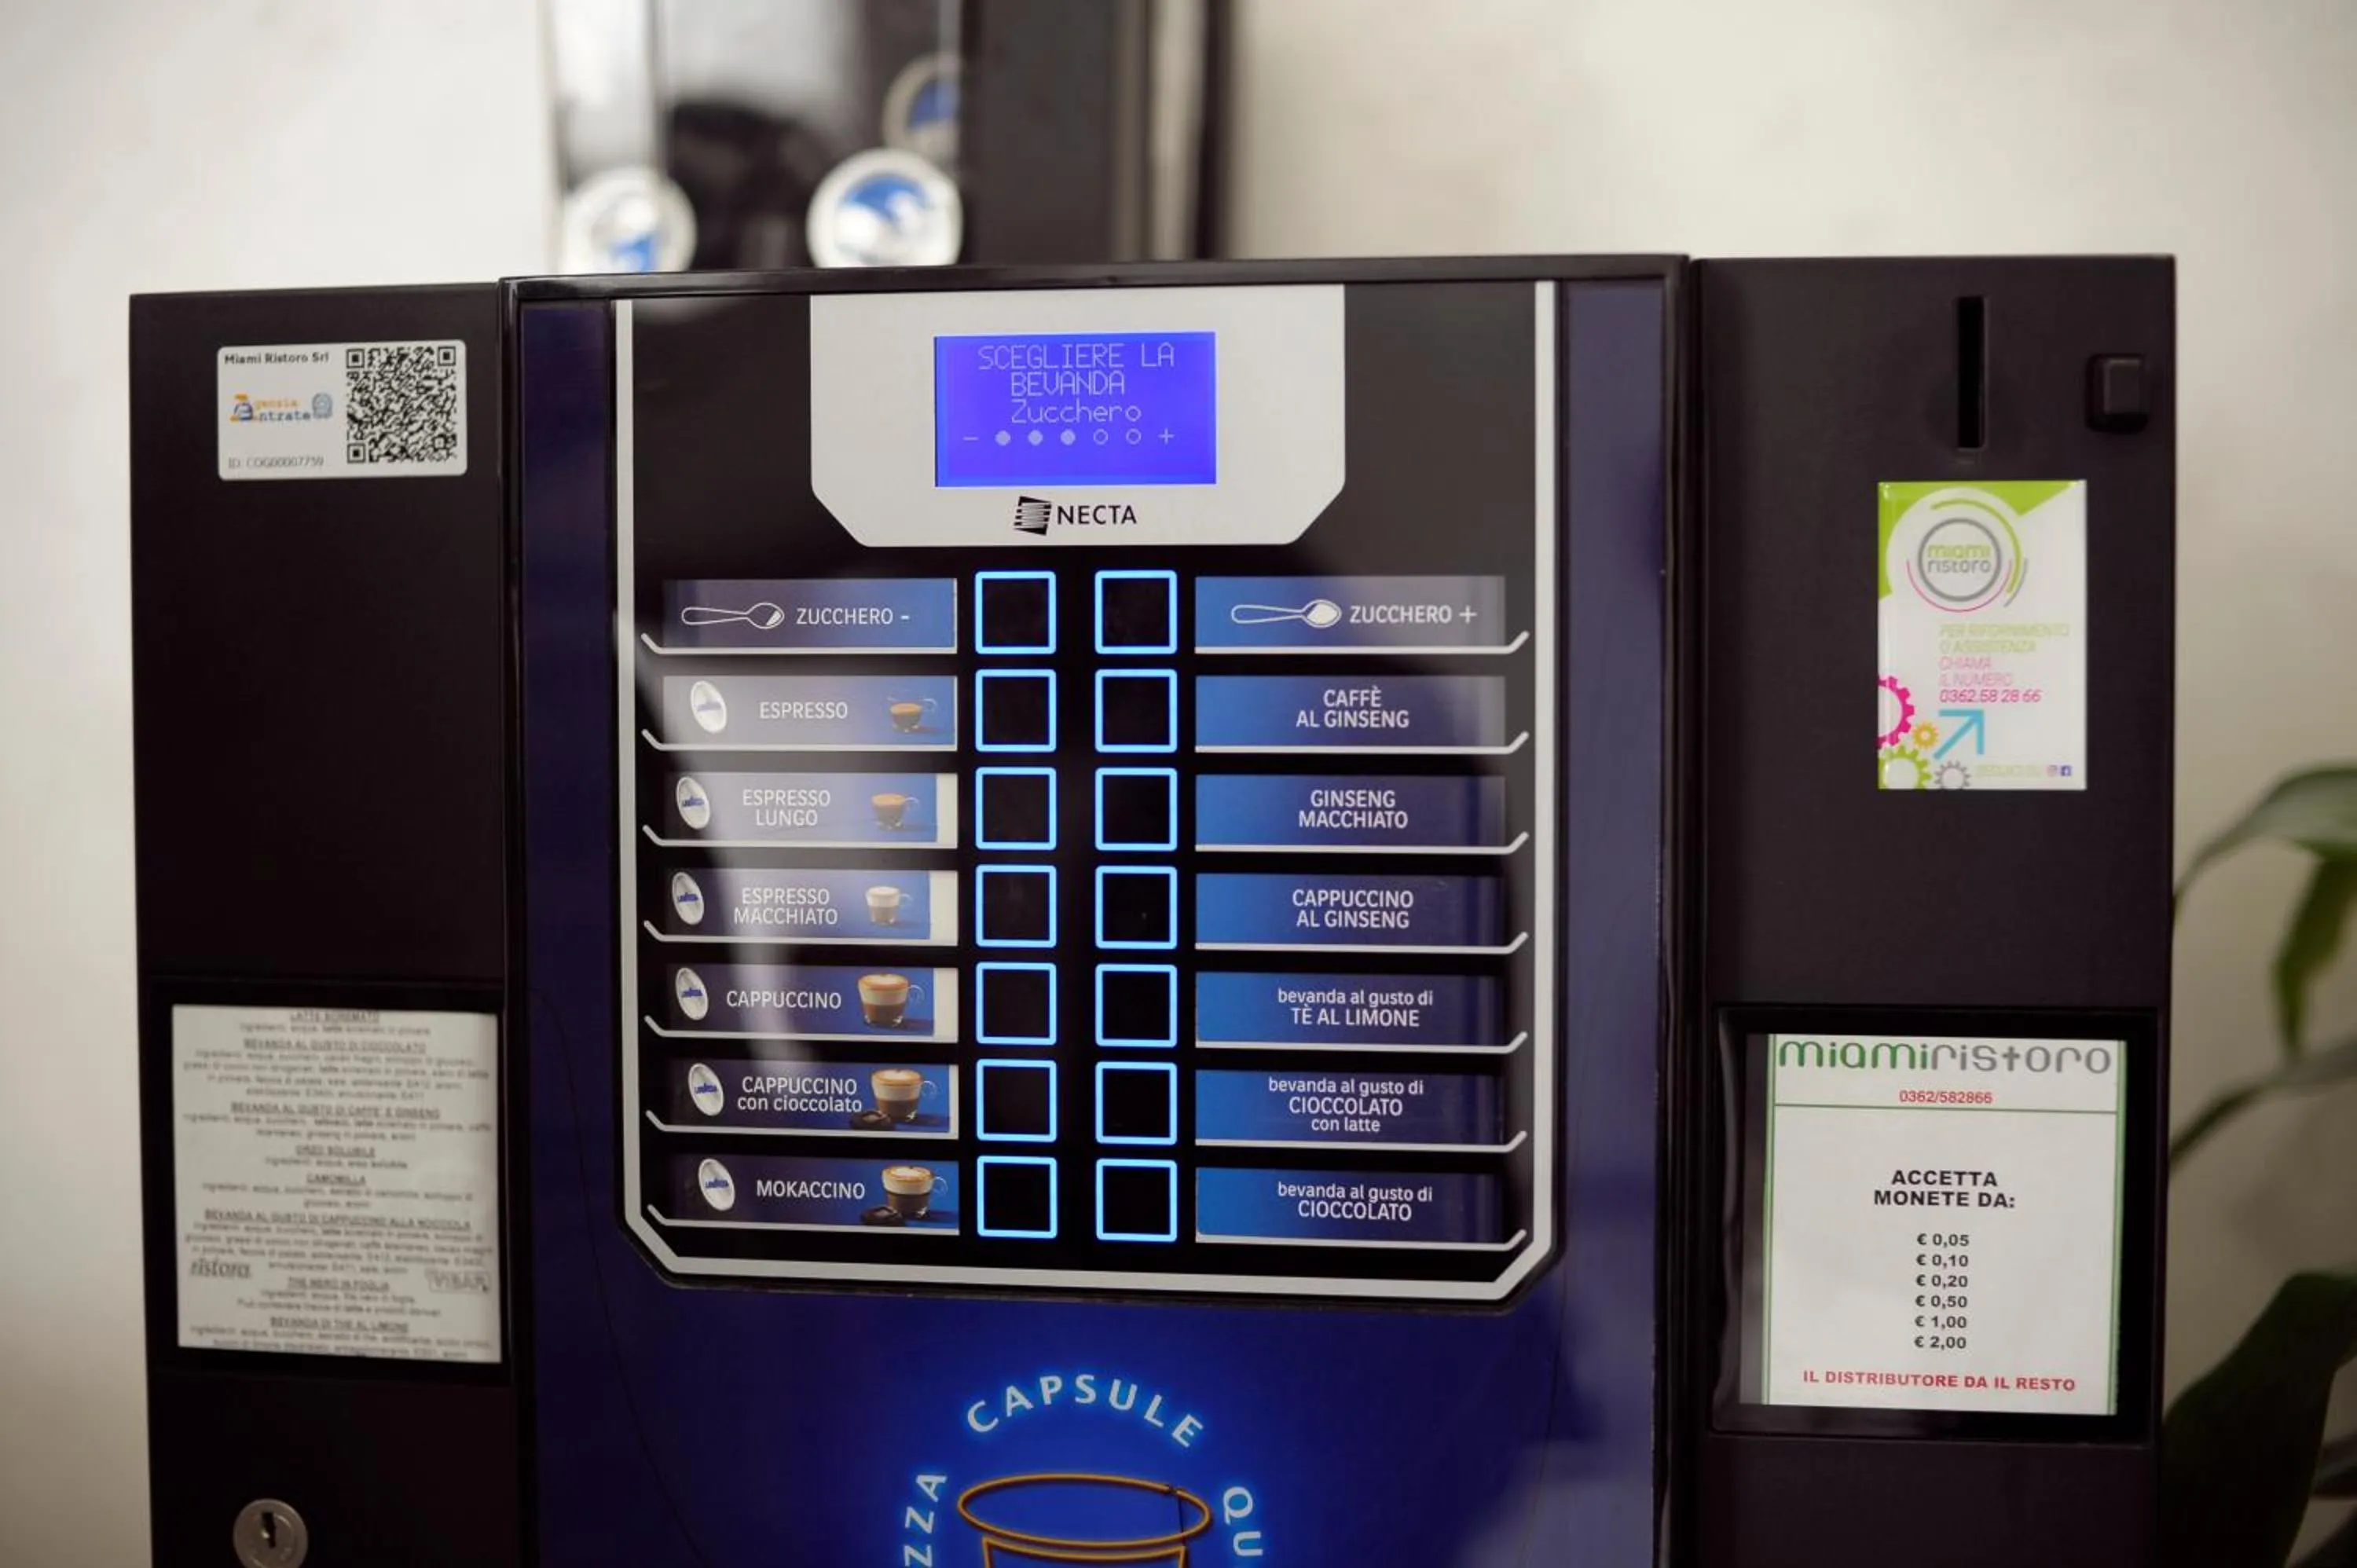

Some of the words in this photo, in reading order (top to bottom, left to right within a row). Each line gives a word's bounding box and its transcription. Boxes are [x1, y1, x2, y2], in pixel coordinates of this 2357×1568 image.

[224, 354, 262, 365] Miami
[265, 353, 308, 364] Ristoro
[312, 352, 329, 362] Srl
[978, 343, 1124, 369] SCEGLIERE
[1141, 343, 1175, 367] LA
[1011, 370, 1125, 397] BEVANDA
[1011, 398, 1142, 423] Zucchero
[1057, 505, 1137, 525] NECTA
[1927, 544, 1990, 559] miami
[1928, 560, 1990, 573] ristoro
[796, 608, 893, 625] ZUCCHERO
[1350, 605, 1452, 624] ZUCCHERO
[1323, 686, 1382, 707] CAFFÈ
[760, 702, 848, 719] ESPRESSO
[1296, 709, 1319, 727] AL
[1324, 709, 1409, 728] GINSENG
[742, 789, 830, 807] ESPRESSO
[1310, 789, 1395, 808] GINSENG
[756, 809, 818, 826] LUNGO
[1299, 810, 1409, 829] MACCHIATO
[742, 887, 830, 905] ESPRESSO
[1292, 888, 1413, 908] CAPPUCCINO
[734, 907, 838, 925] MACCHIATO
[1296, 910, 1319, 928] AL
[1325, 910, 1409, 929] GINSENG
[726, 991, 842, 1009] CAPPUCCINO
[1278, 987, 1345, 1005] bevanda
[1351, 989, 1365, 1005] al
[1369, 991, 1414, 1008] gusto
[1417, 990, 1433, 1006] di
[1292, 1003, 1311, 1025] TÈ
[1318, 1008, 1339, 1025] AL
[1346, 1009, 1420, 1027] LIMONE
[742, 1076, 857, 1095] CAPPUCCINO
[1269, 1077, 1336, 1094] bevanda
[1341, 1078, 1355, 1094] al
[1359, 1081, 1405, 1097] gusto
[1408, 1079, 1424, 1095] di
[737, 1097, 768, 1111] con
[773, 1095, 863, 1113] cioccolato
[1289, 1097, 1402, 1116] CIOCCOLATO
[1899, 1090, 1992, 1105] 0362/582866
[1311, 1118, 1340, 1131] con
[1344, 1117, 1380, 1132] latte
[1891, 1170, 1998, 1187] ACCETTA
[756, 1180, 865, 1200] MOKACCINO
[1278, 1181, 1345, 1199] bevanda
[1351, 1183, 1365, 1199] al
[1369, 1186, 1413, 1203] gusto
[1417, 1186, 1432, 1202] di
[1874, 1190, 1970, 1207] MONETE
[1978, 1192, 2015, 1208] DA:
[1298, 1200, 1412, 1222] CIOCCOLATO
[1917, 1233, 1927, 1246] €
[1933, 1233, 1970, 1247] 0,05
[1916, 1255, 1926, 1266] €
[1932, 1255, 1969, 1268] 0,10
[1915, 1274, 1926, 1287] €
[1931, 1274, 1968, 1289] 0,20
[1915, 1295, 1926, 1307] €
[1930, 1295, 1967, 1310] 0,50
[1915, 1316, 1925, 1328] €
[1930, 1316, 1967, 1330] 1,00
[1914, 1336, 1924, 1348] €
[1930, 1336, 1967, 1350] 2,00
[1803, 1370, 1819, 1383] IL
[1825, 1371, 1958, 1388] DISTRIBUTORE
[1964, 1376, 1988, 1389] DA
[1994, 1377, 2010, 1390] IL
[2016, 1377, 2076, 1392] RESTO
[967, 1373, 1204, 1448] CAPSULE
